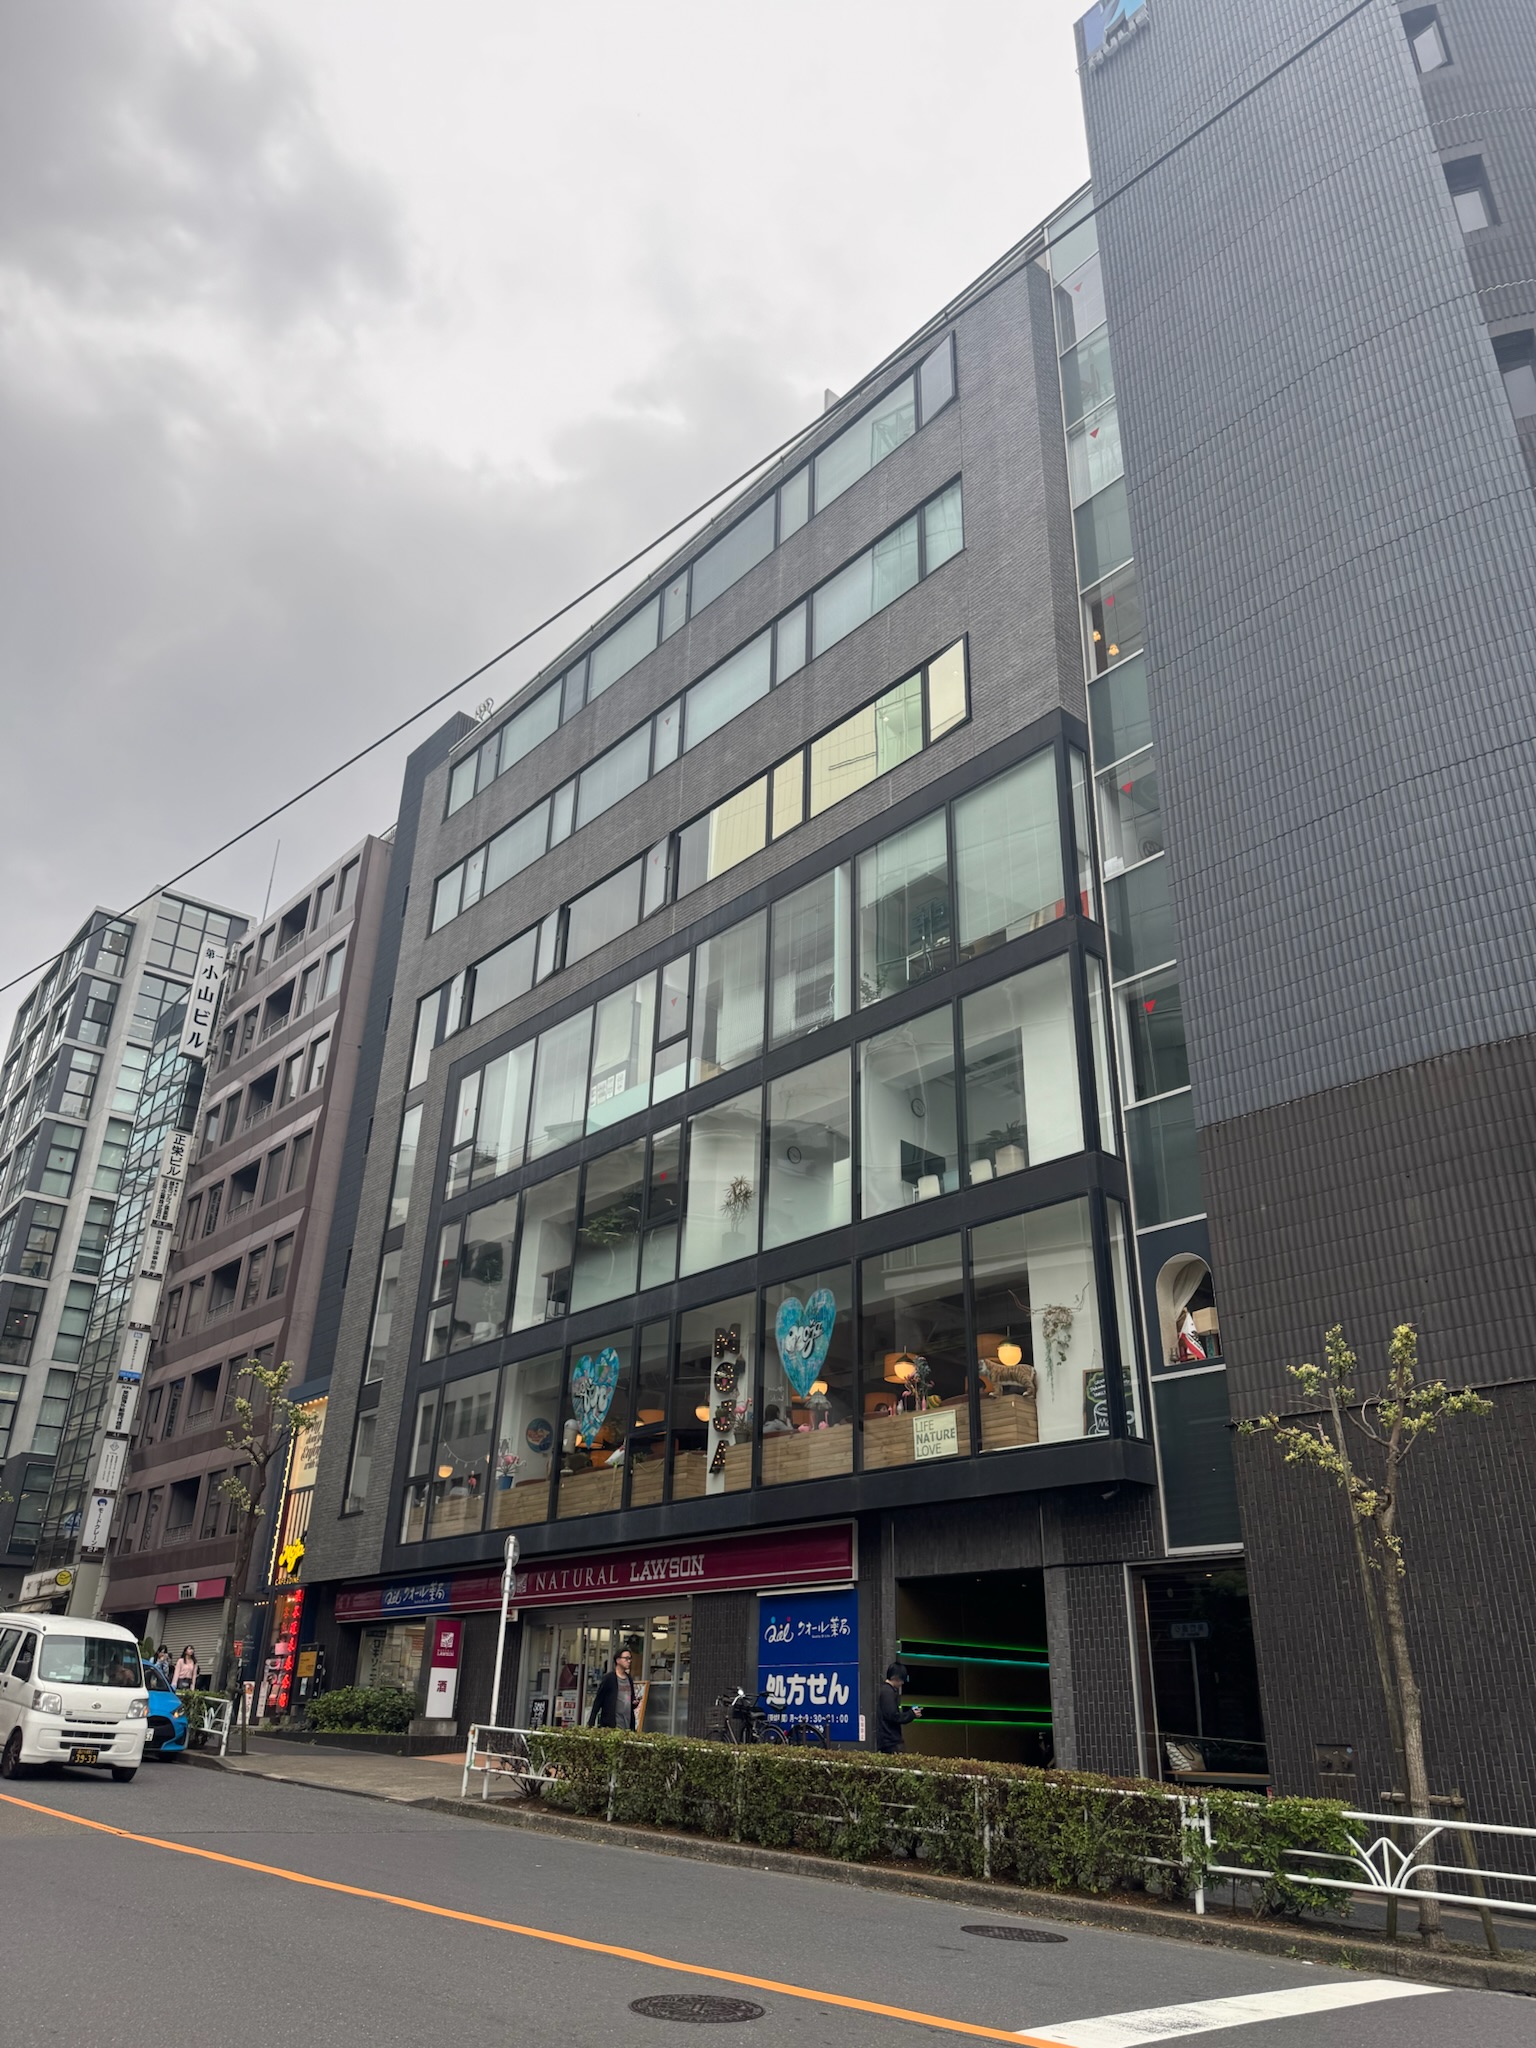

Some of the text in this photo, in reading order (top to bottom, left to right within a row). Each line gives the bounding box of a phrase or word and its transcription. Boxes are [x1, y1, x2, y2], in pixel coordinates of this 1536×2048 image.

[206, 948, 224, 959] 第一
[187, 965, 218, 1049] 小山ビル
[167, 1133, 186, 1176] 正栄ビル
[916, 1420, 934, 1432] LIFE
[916, 1428, 956, 1445] NATURE
[917, 1443, 941, 1457] LOVE
[535, 1554, 705, 1592] NATURAL LAWSON
[402, 1581, 445, 1602] クオール薬局
[797, 1616, 851, 1638] クオール薬局
[436, 1680, 447, 1693] 酒
[766, 1672, 850, 1705] 処方せん
[74, 1754, 97, 1764] 39-33
